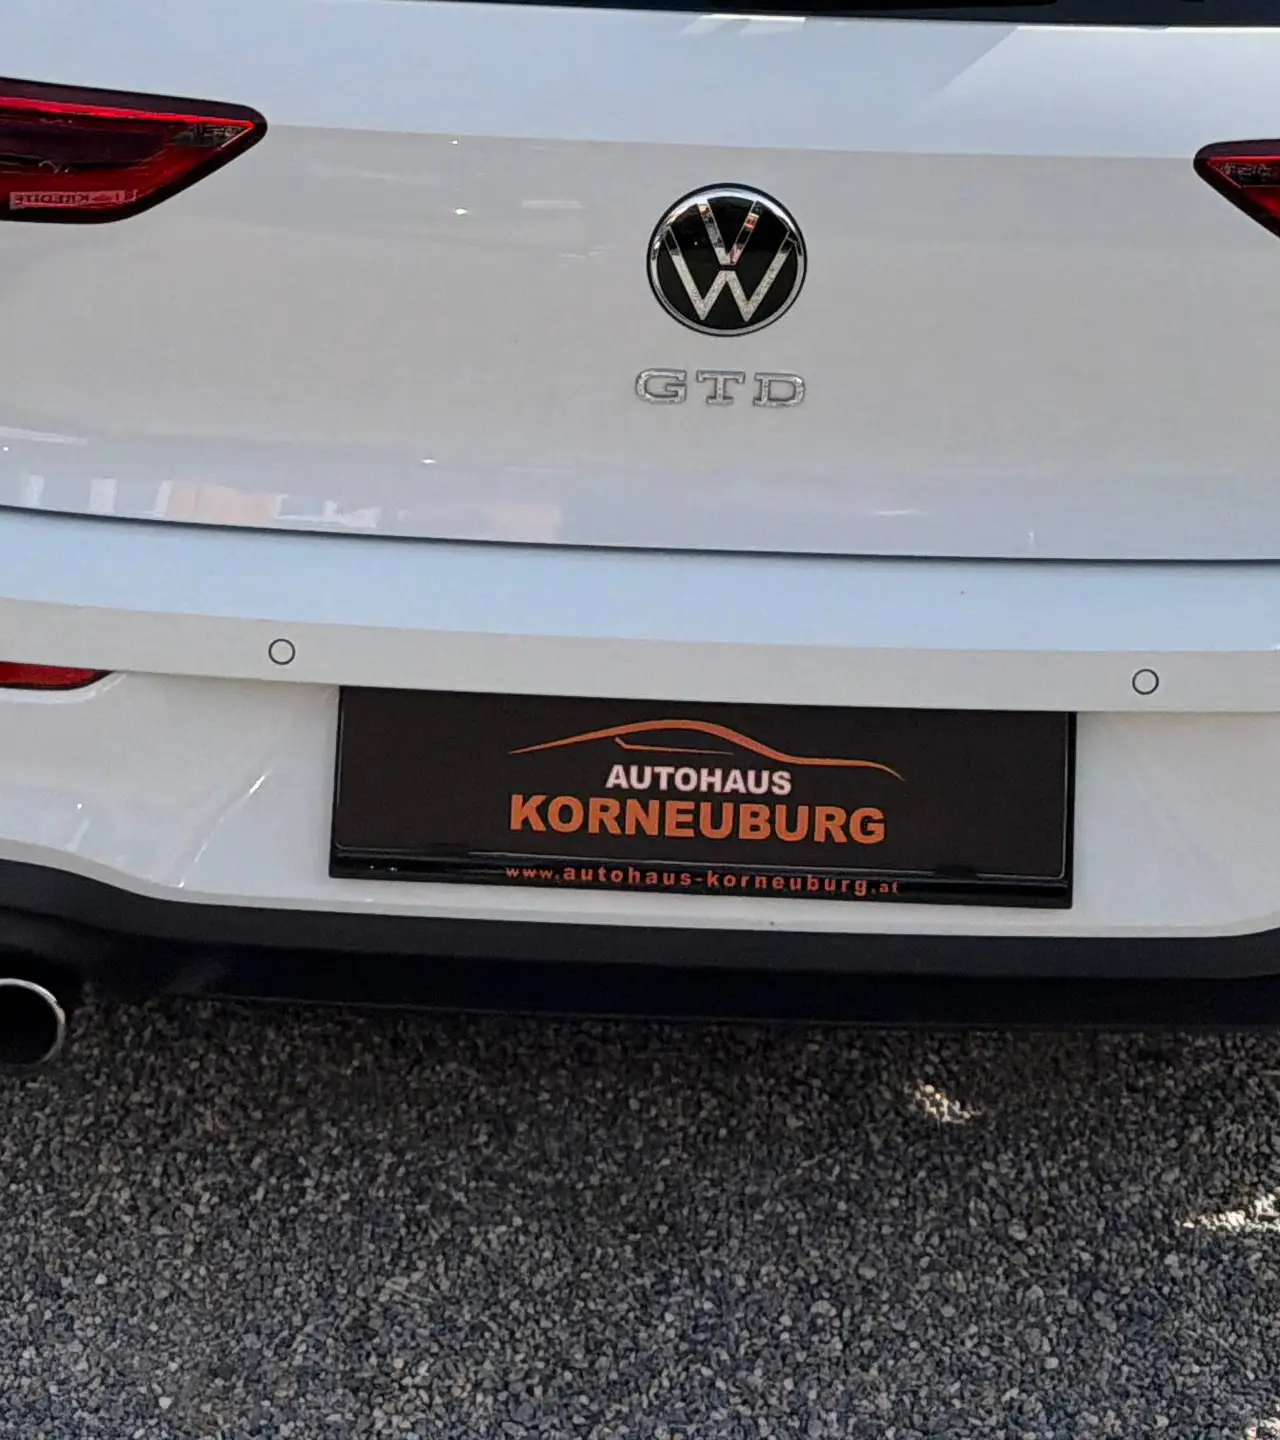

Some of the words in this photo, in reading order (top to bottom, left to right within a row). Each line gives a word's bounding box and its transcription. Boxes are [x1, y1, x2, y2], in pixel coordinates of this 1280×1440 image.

[634, 367, 807, 408] GTD
[604, 763, 793, 797] AUTOHAUS
[509, 794, 887, 845] KORNEUBURG
[505, 864, 901, 897] www.autohaus-korneuburg.at
